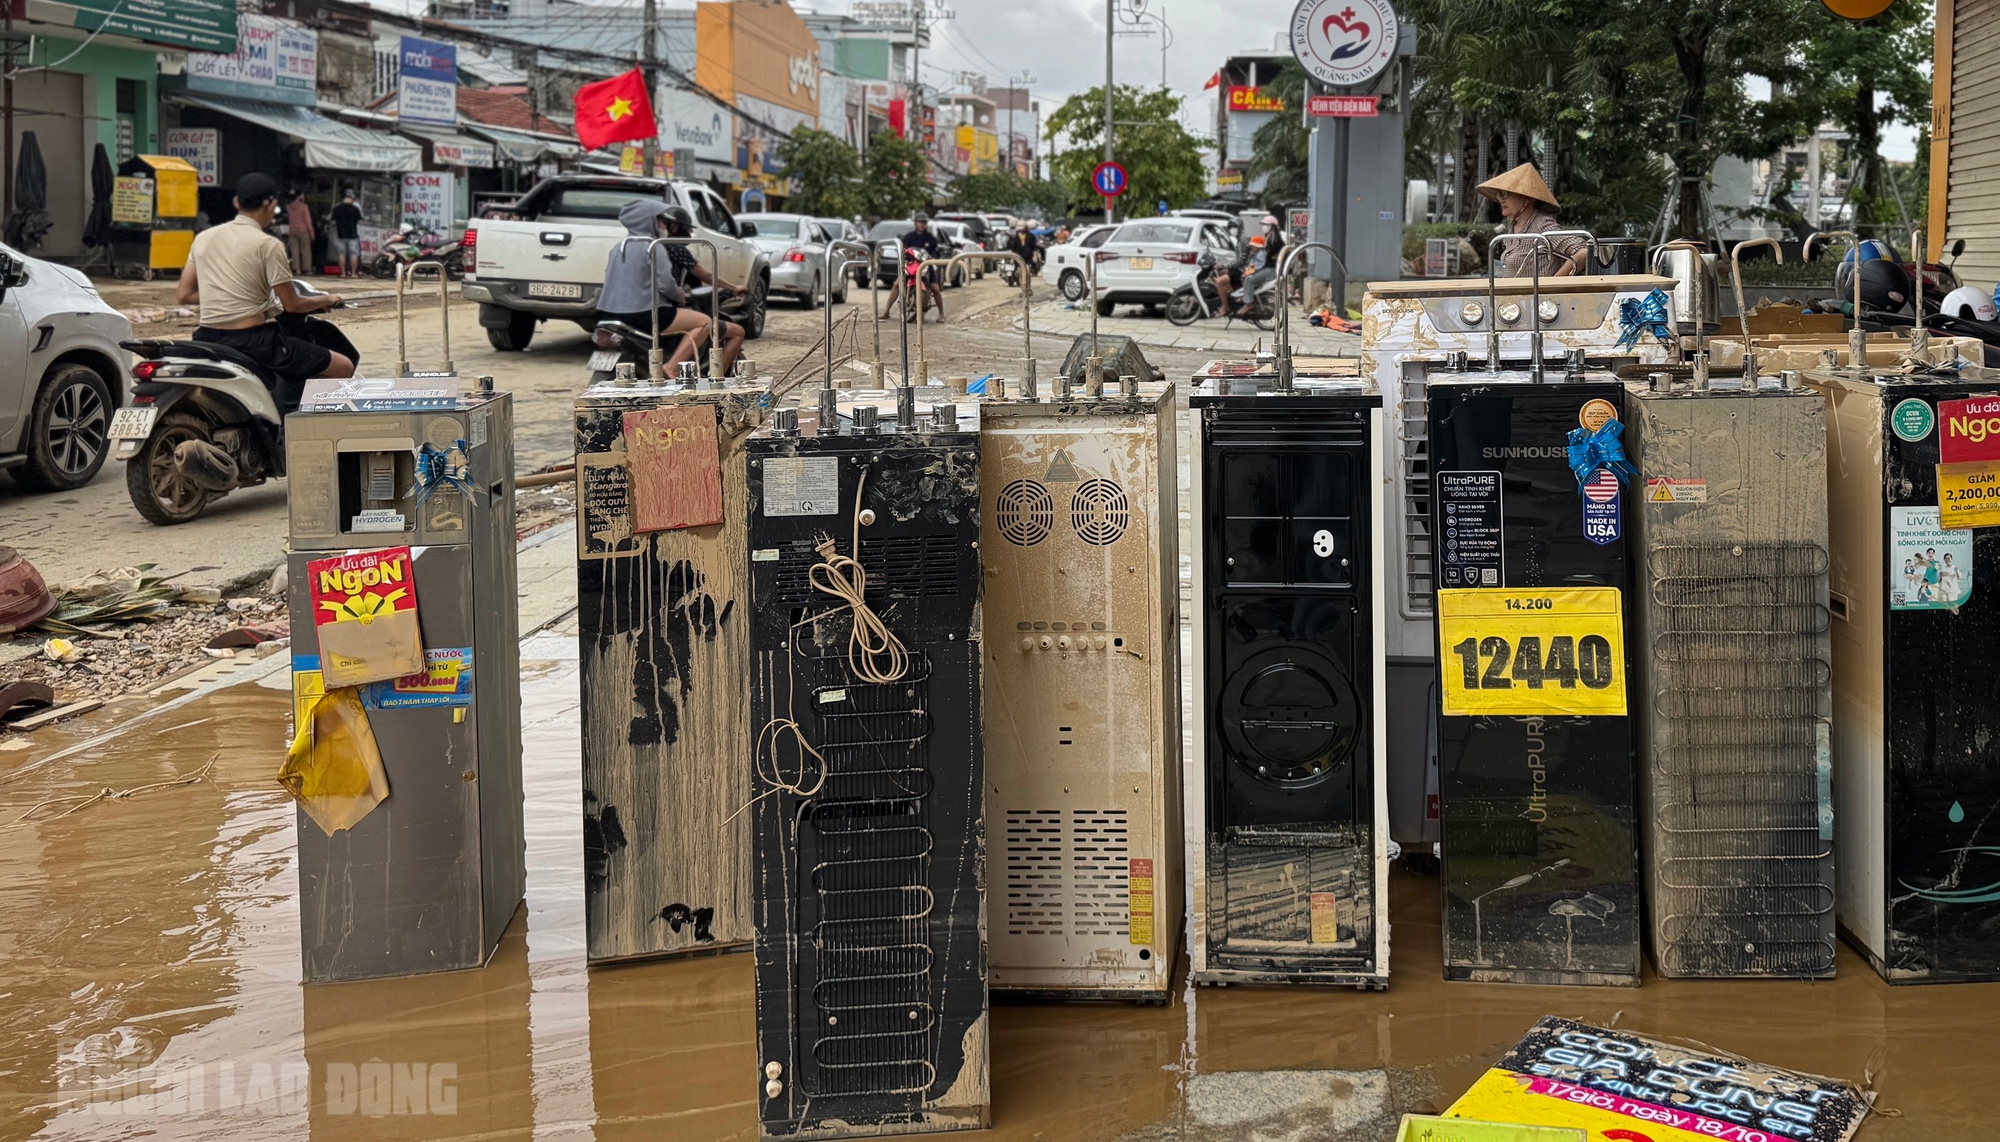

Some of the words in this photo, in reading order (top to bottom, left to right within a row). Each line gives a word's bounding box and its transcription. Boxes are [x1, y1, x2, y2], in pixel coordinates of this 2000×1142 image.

[1296, 15, 1307, 45] BỆNH
[1303, 0, 1320, 13] VIỆ
[1384, 20, 1394, 43] VỰC
[789, 49, 818, 101] yody
[1314, 65, 1350, 82] QUẢNG
[1351, 65, 1374, 81] NAM
[1312, 99, 1328, 114] BỆNH
[1329, 99, 1342, 114] VIỆN
[1344, 99, 1358, 114] ĐIỆN
[1359, 98, 1372, 112] BÀN
[674, 121, 713, 146] VietinBank
[404, 174, 441, 188] CƠM
[362, 400, 372, 410] 4
[1966, 402, 1981, 414] Ưu
[120, 410, 149, 423] 92-C1
[1949, 416, 2000, 442] Ngo
[589, 482, 628, 491] Kangaro
[1442, 476, 1495, 485] UltraPURE
[1950, 504, 1962, 512] Chỉ
[356, 516, 402, 524] HYDROGEN
[1906, 516, 1940, 526] LIVOT
[1588, 524, 1617, 537] USA
[341, 557, 358, 571] Ưu
[360, 555, 378, 568] đãi
[319, 560, 404, 595] NgoN
[1504, 598, 1552, 610] 14.200
[434, 650, 464, 658] NƯỚC
[1544, 1048, 1626, 1077] GIA
[1589, 1075, 1668, 1101] XINH
[1547, 1082, 1615, 1110] 17giờ,
[1620, 1102, 1690, 1127] ngày
[1695, 1117, 1768, 1142] 18/10
